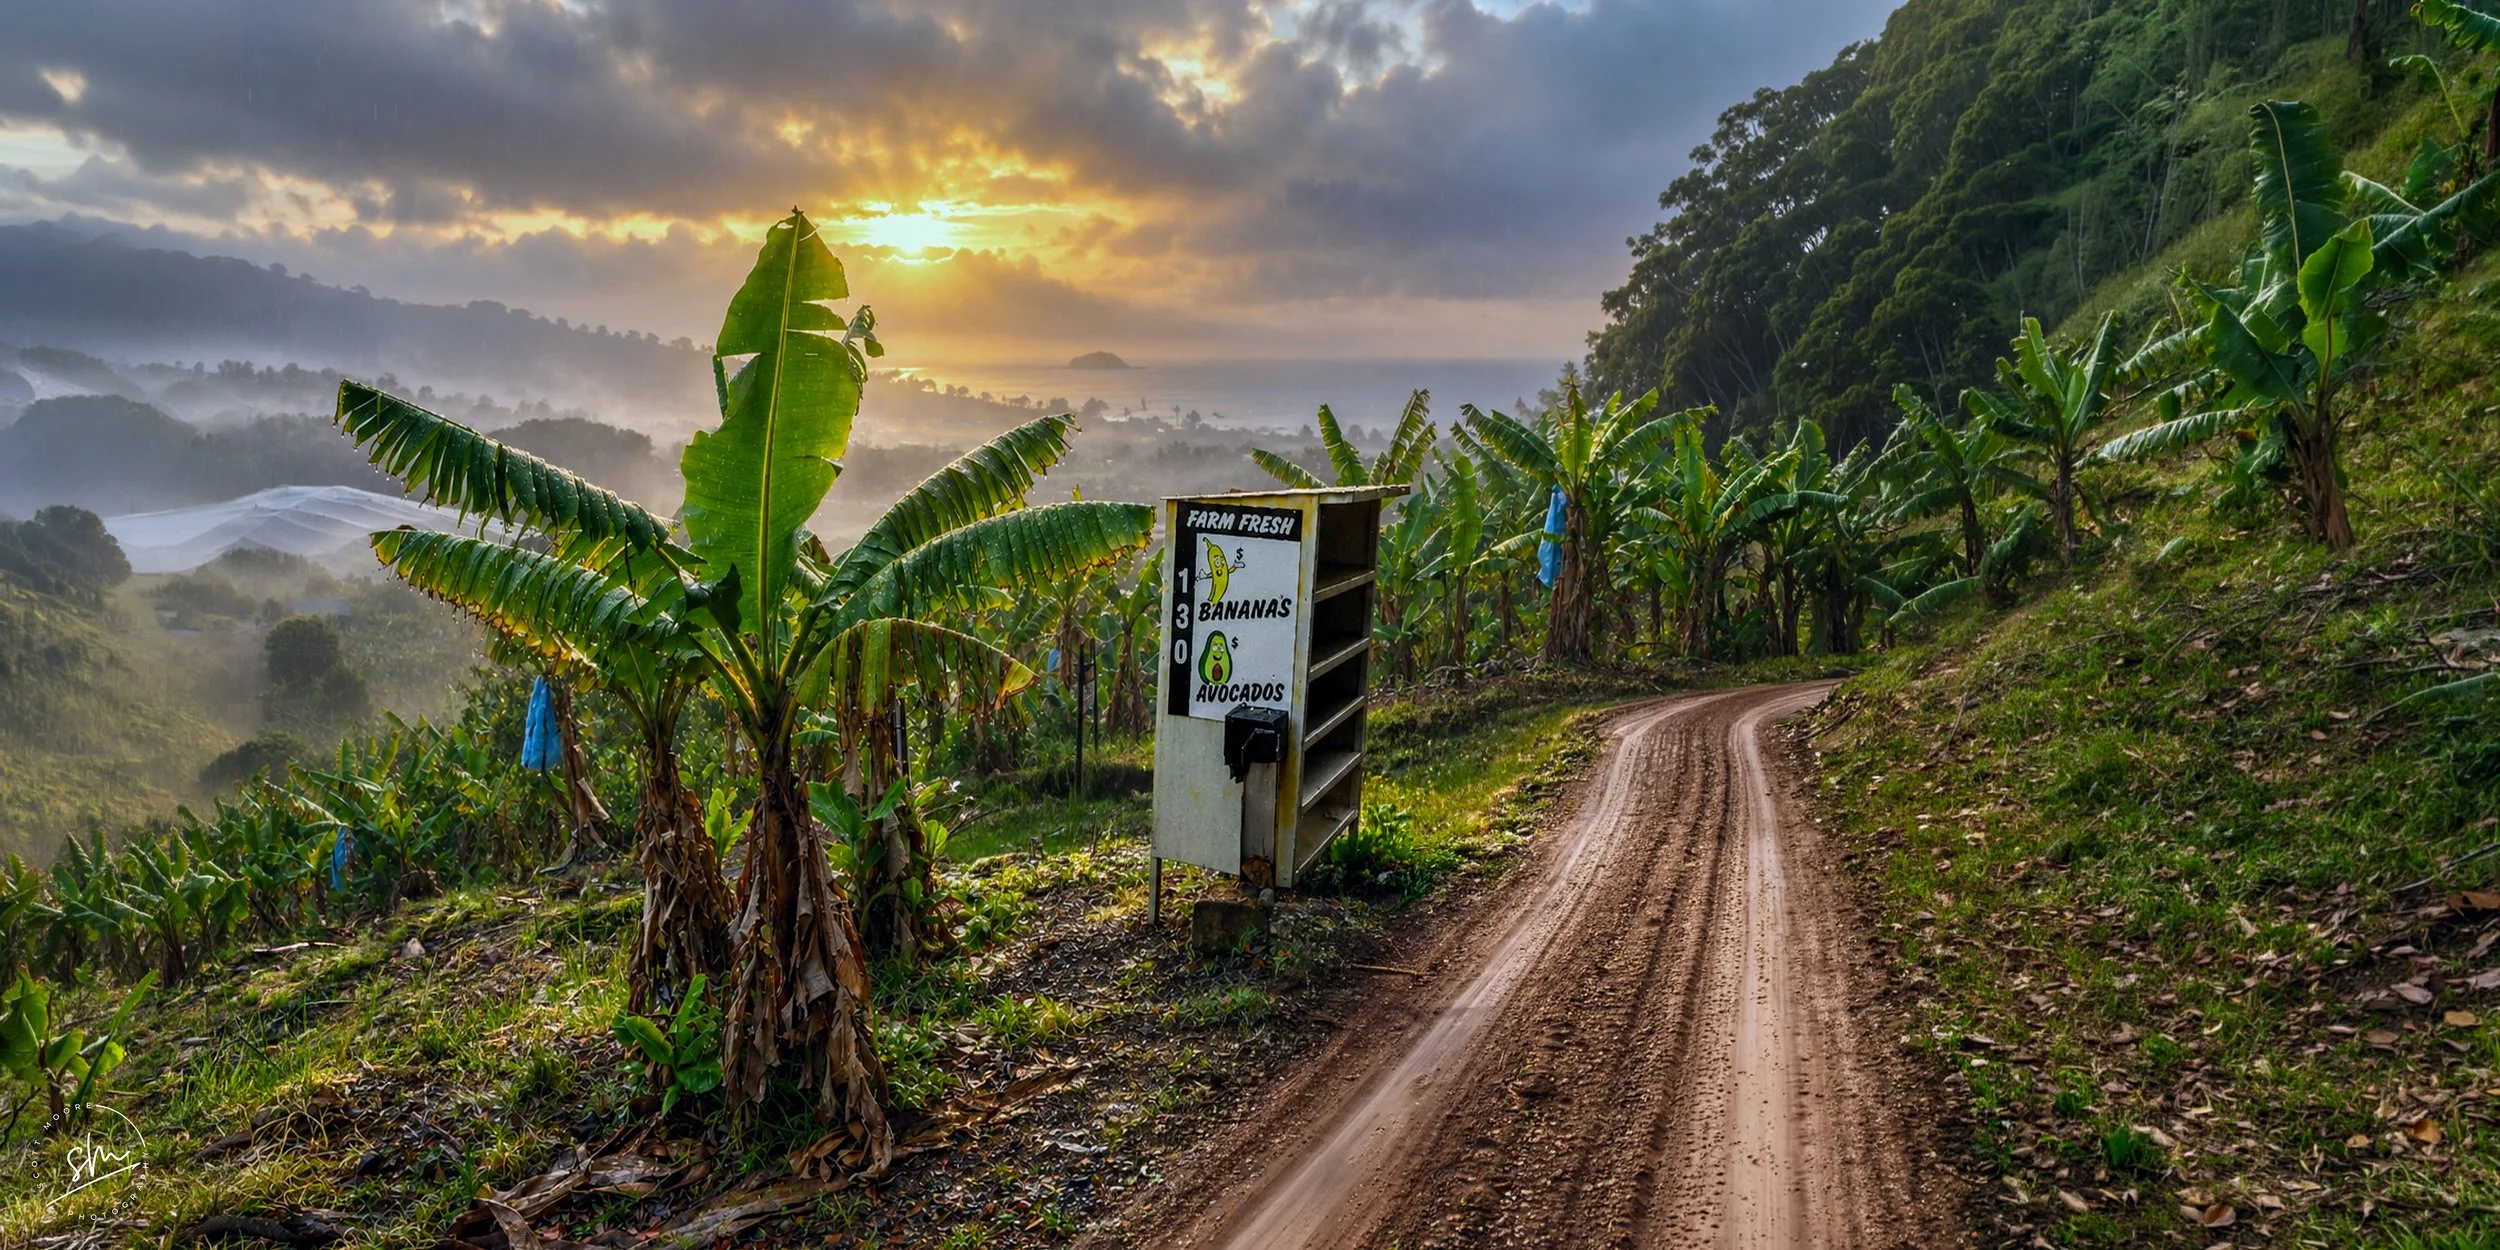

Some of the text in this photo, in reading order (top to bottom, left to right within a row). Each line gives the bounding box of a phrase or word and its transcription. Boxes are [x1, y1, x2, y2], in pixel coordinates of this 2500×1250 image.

[1186, 509, 1295, 536] FARM FRESH
[1235, 546, 1244, 562] $
[1197, 594, 1292, 623] BANANA'S
[1231, 636, 1239, 650] $
[1195, 682, 1285, 704] AVOCADOS
